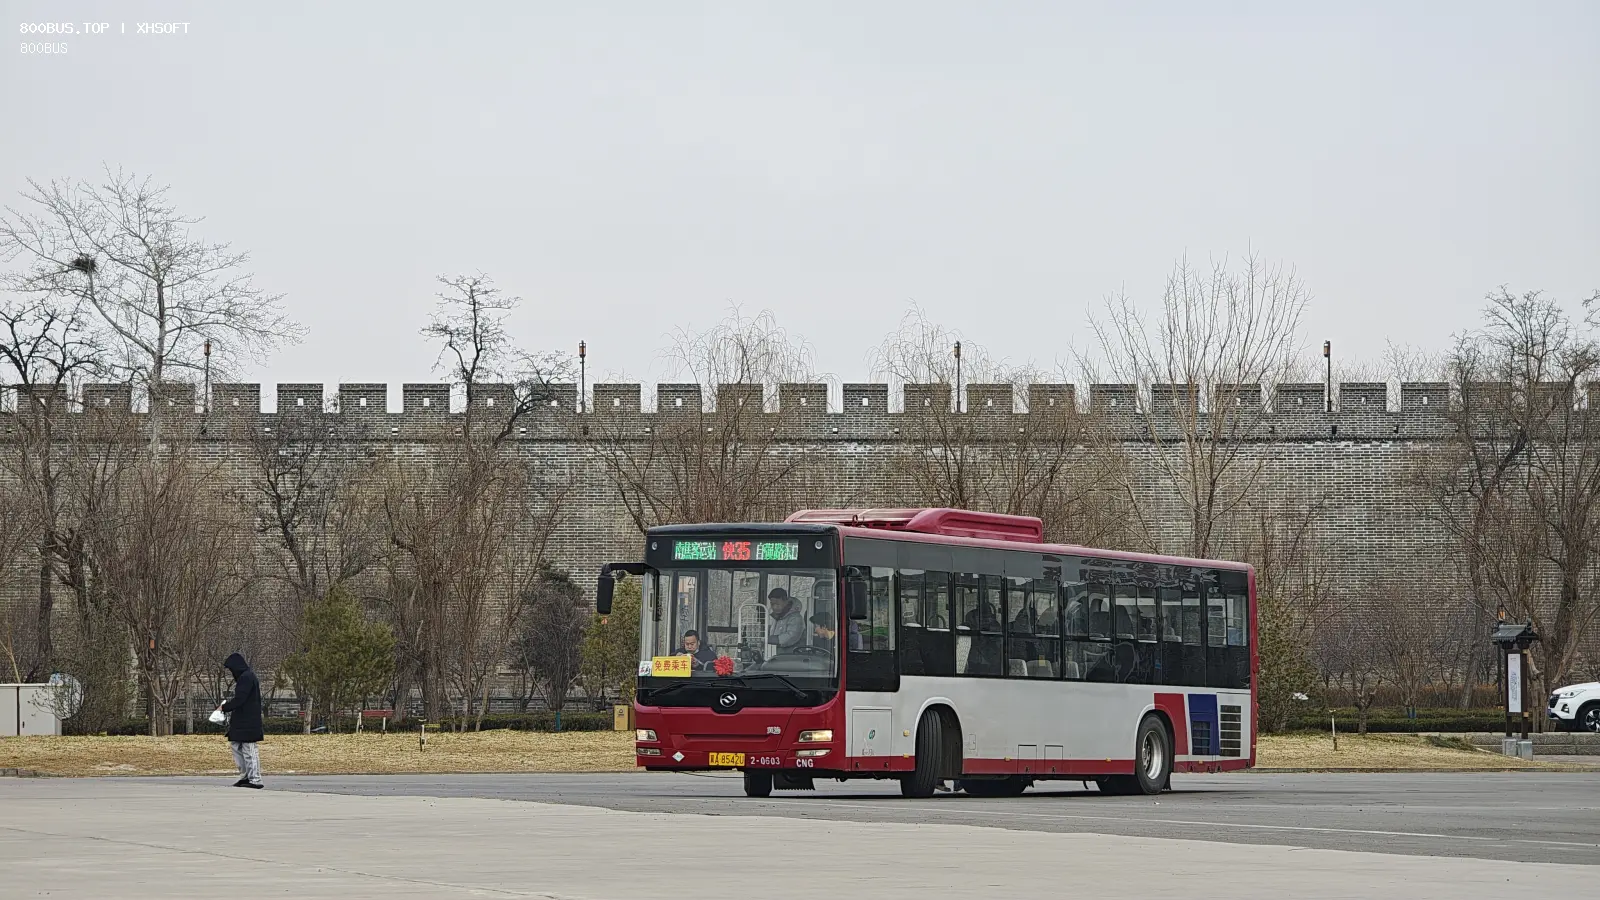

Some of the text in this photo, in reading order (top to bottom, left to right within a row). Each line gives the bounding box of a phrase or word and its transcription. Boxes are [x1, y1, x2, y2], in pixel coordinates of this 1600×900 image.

[654, 659, 688, 672] 免费乘车
[750, 756, 781, 766] 2-0603
[796, 758, 814, 768] CNG
